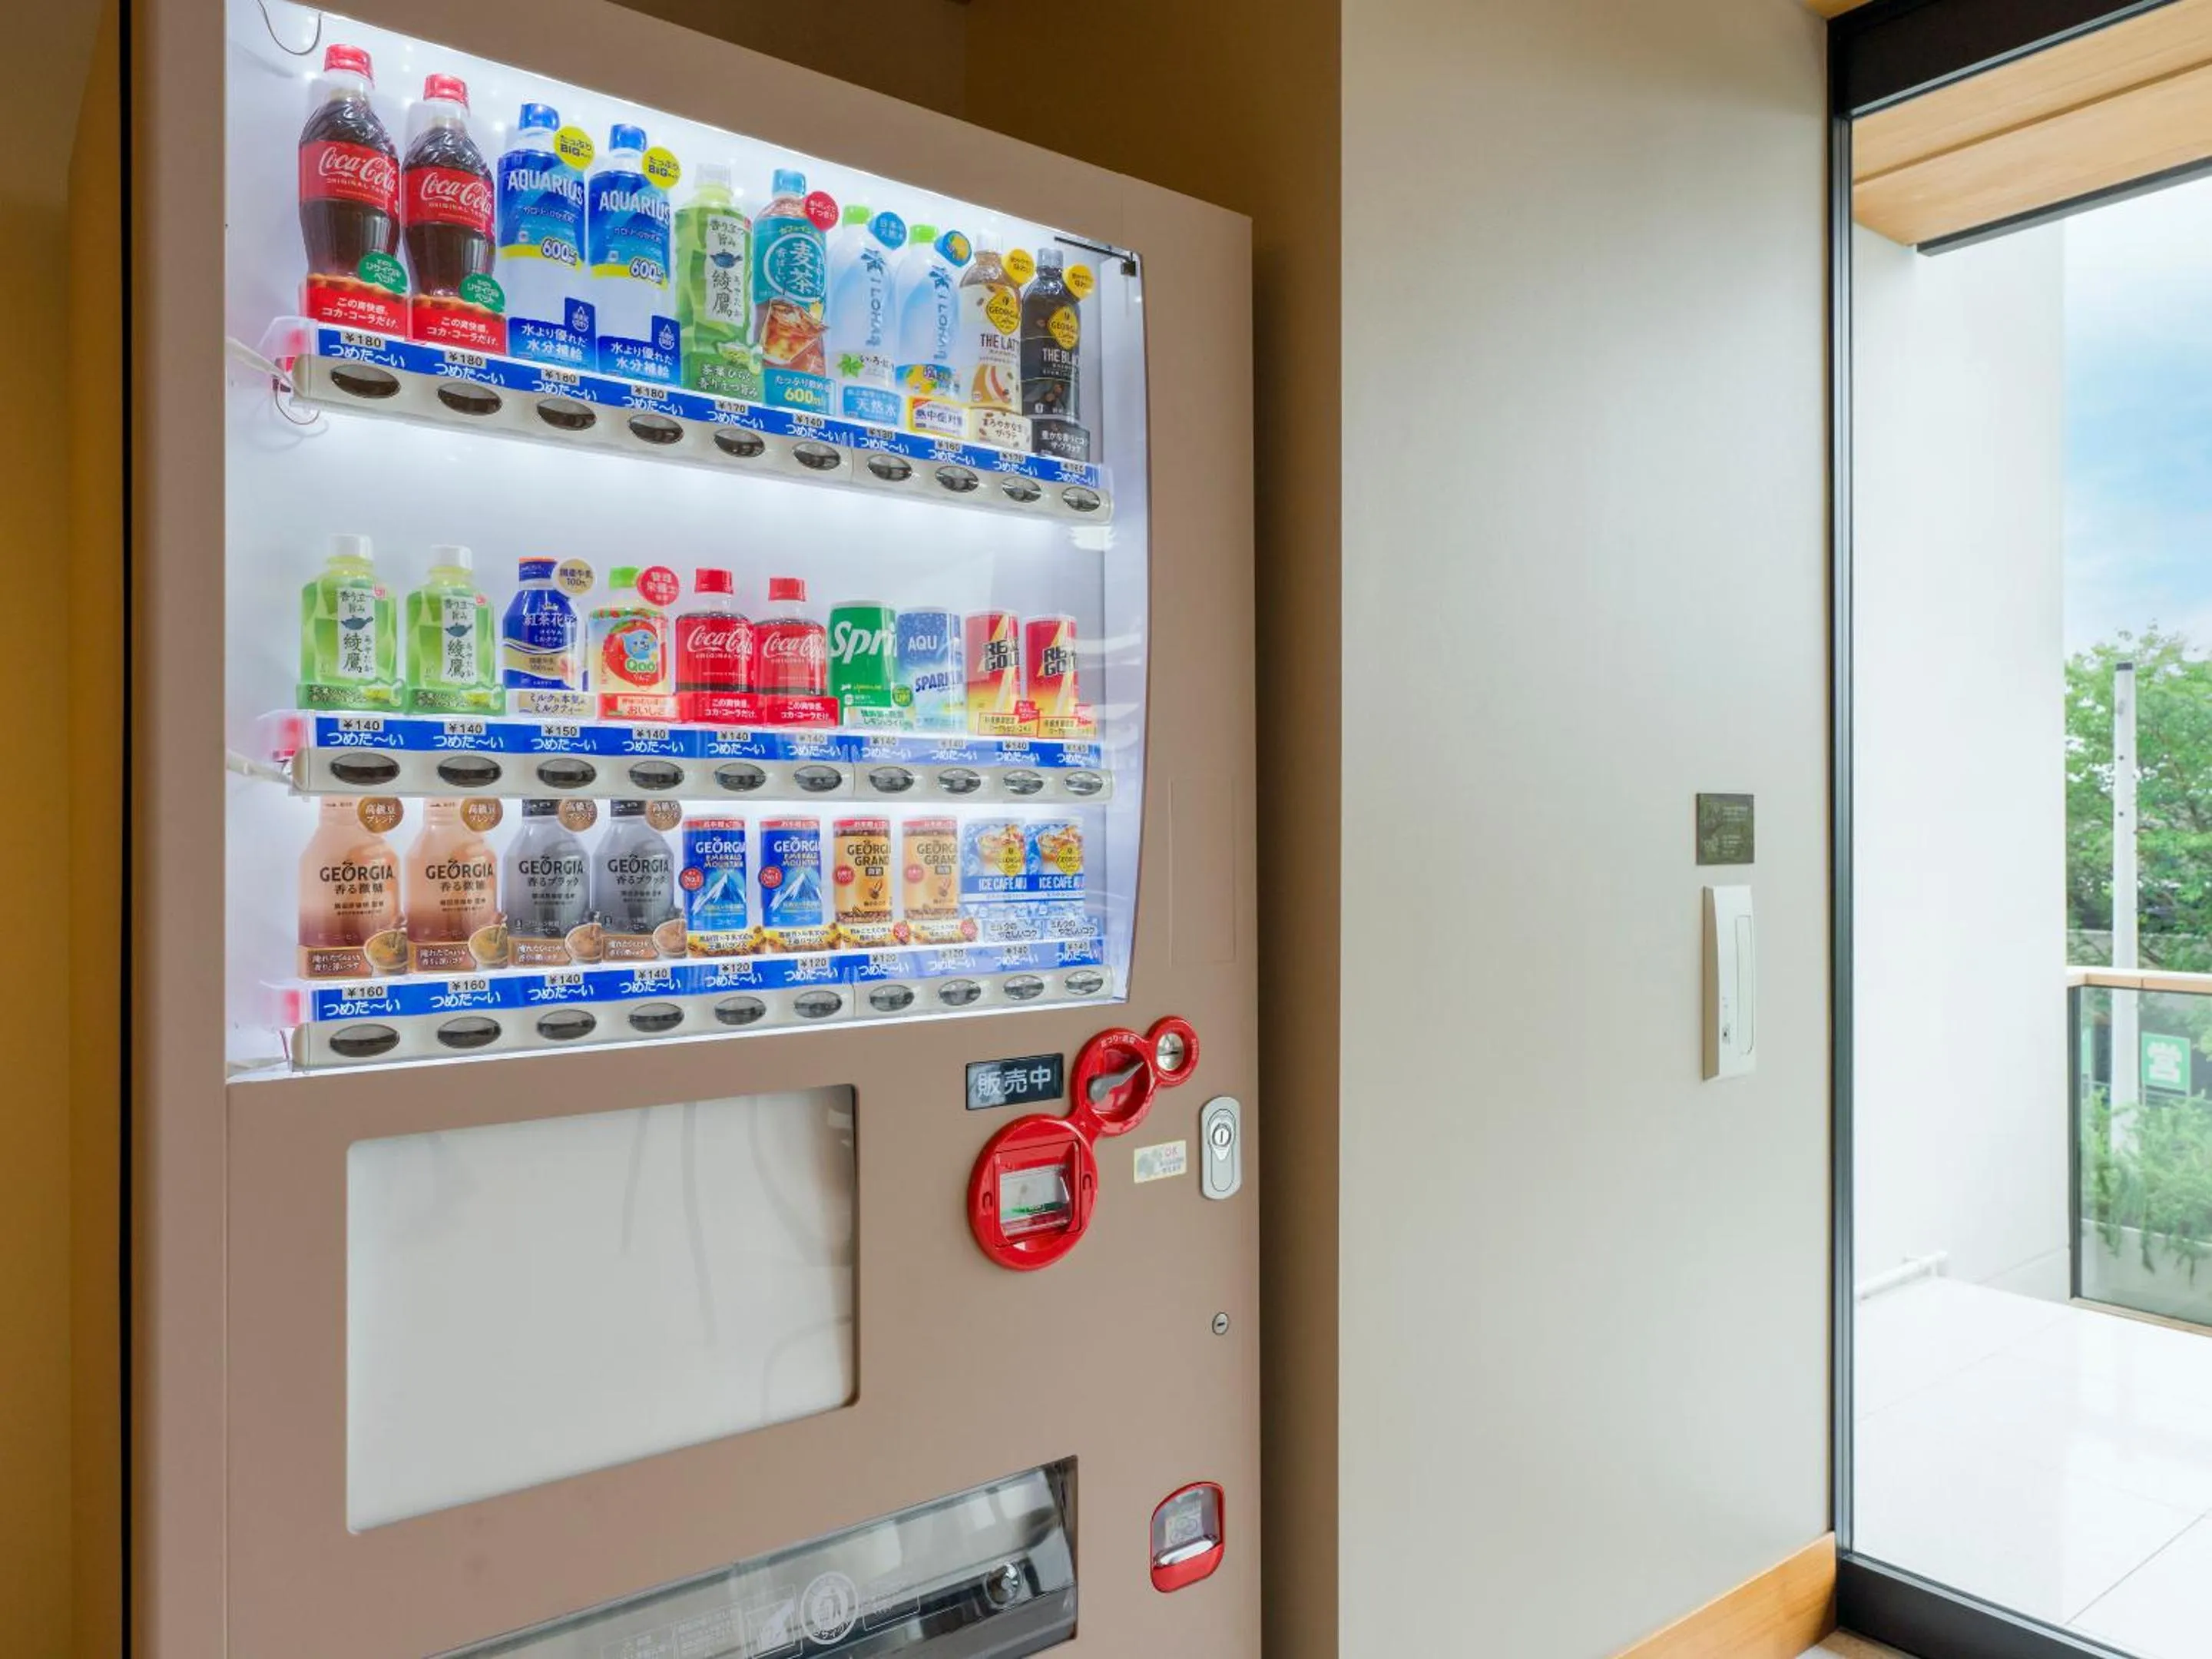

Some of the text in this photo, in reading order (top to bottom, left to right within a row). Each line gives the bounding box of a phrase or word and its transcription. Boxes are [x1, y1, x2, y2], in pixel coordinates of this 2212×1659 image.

[560, 135, 591, 151] たっぷり
[318, 147, 395, 191] Coca-Cola
[420, 172, 492, 214] Coca-Cola
[508, 170, 584, 206] AQUARIUS
[599, 191, 671, 224] AQUARIUS
[787, 240, 814, 295] 麦茶
[712, 270, 733, 317] 綾鷹
[345, 333, 382, 347] ¥180
[521, 323, 589, 346] 水より優れた
[981, 334, 998, 347] THE
[528, 340, 583, 361] 水分補給
[611, 343, 674, 365] 水より優れた
[1042, 348, 1060, 362] THE
[449, 352, 483, 366] ¥180
[616, 357, 670, 379] 水分補給
[545, 371, 576, 382] ¥180
[634, 386, 664, 398] ¥180
[719, 402, 746, 413] ¥170
[857, 399, 896, 417] 天然水
[343, 634, 363, 674] 綾鷹
[447, 639, 465, 678] 綾鷹
[343, 720, 380, 731] ¥140
[449, 724, 483, 734] ¥140
[545, 726, 576, 737] ¥150
[636, 730, 666, 739] ¥140
[720, 731, 748, 741] ¥140
[320, 859, 394, 882] GEORGIA
[721, 962, 750, 972] ¥120
[800, 959, 826, 968] ¥120
[549, 974, 580, 984] ¥140
[638, 969, 667, 979] ¥140
[347, 986, 383, 997] ¥160
[452, 980, 485, 991] ¥160
[978, 1065, 1051, 1098] 販売中
